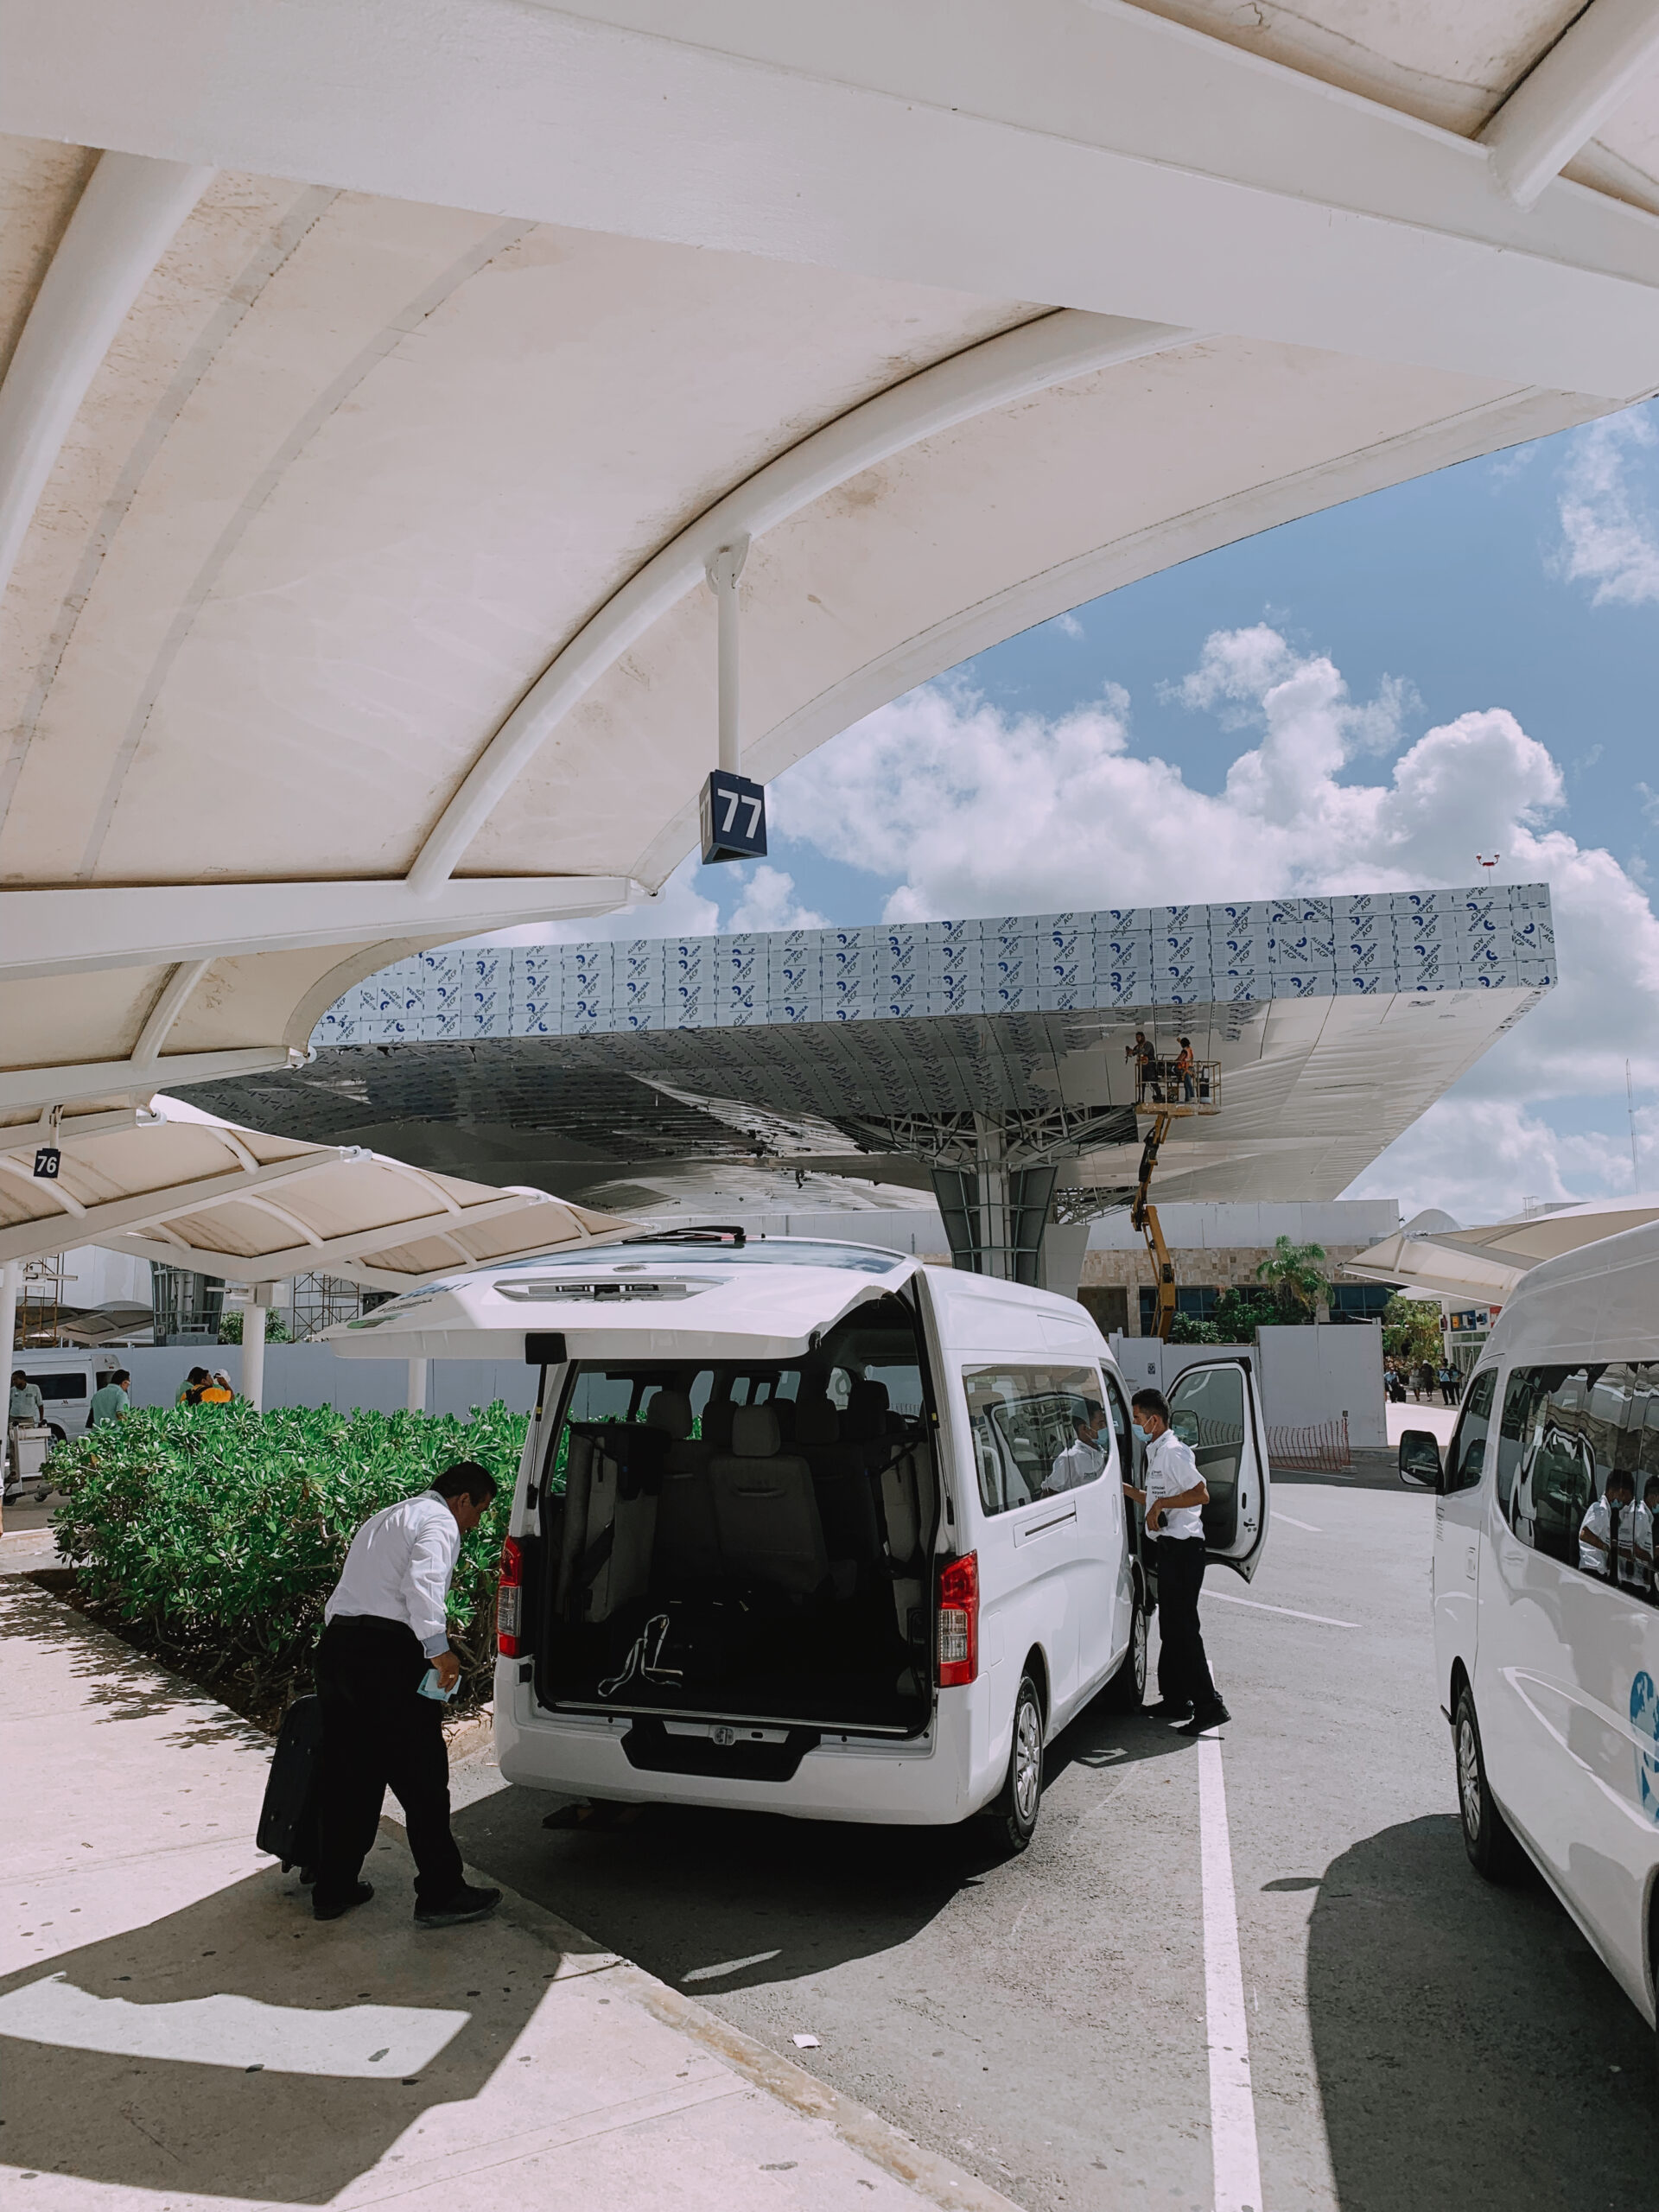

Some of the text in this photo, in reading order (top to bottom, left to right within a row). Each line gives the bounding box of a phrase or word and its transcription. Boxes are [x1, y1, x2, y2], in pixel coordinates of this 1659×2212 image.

[717, 788, 762, 839] 77
[1361, 898, 1371, 912] ACP
[1008, 917, 1018, 931] ACP
[1178, 913, 1189, 927] ACP
[953, 930, 963, 942] ACP
[1362, 925, 1373, 938] ACP
[1426, 925, 1437, 938] ACP
[1008, 943, 1019, 956] ACP
[1472, 938, 1484, 951] ACP
[793, 950, 804, 963] ACP
[1065, 946, 1075, 960] ACP
[1122, 952, 1132, 965] ACP
[1179, 947, 1191, 960] ACP
[1239, 950, 1250, 963] ACP
[1282, 949, 1297, 960] ACP
[1314, 948, 1329, 958] ACP
[901, 956, 912, 969] ACP
[954, 957, 964, 969] ACP
[1364, 953, 1375, 967] ACP
[637, 964, 646, 976] ACP
[742, 967, 752, 980] ACP
[847, 962, 857, 975] ACP
[1428, 965, 1440, 979] ACP
[689, 969, 698, 982] ACP
[1009, 971, 1020, 984] ACP
[537, 985, 546, 997] ACP
[588, 983, 597, 995] ACP
[793, 978, 804, 991] ACP
[447, 996, 456, 1008] ACP
[637, 991, 646, 1004] ACP
[847, 990, 857, 1004] ACP
[1122, 991, 1134, 1005] ACP
[484, 1001, 493, 1014] ACP
[955, 999, 965, 1012] ACP
[1010, 999, 1020, 1012] ACP
[446, 1021, 456, 1033] ACP
[484, 1023, 493, 1035] ACP
[37, 1155, 57, 1173] 76
